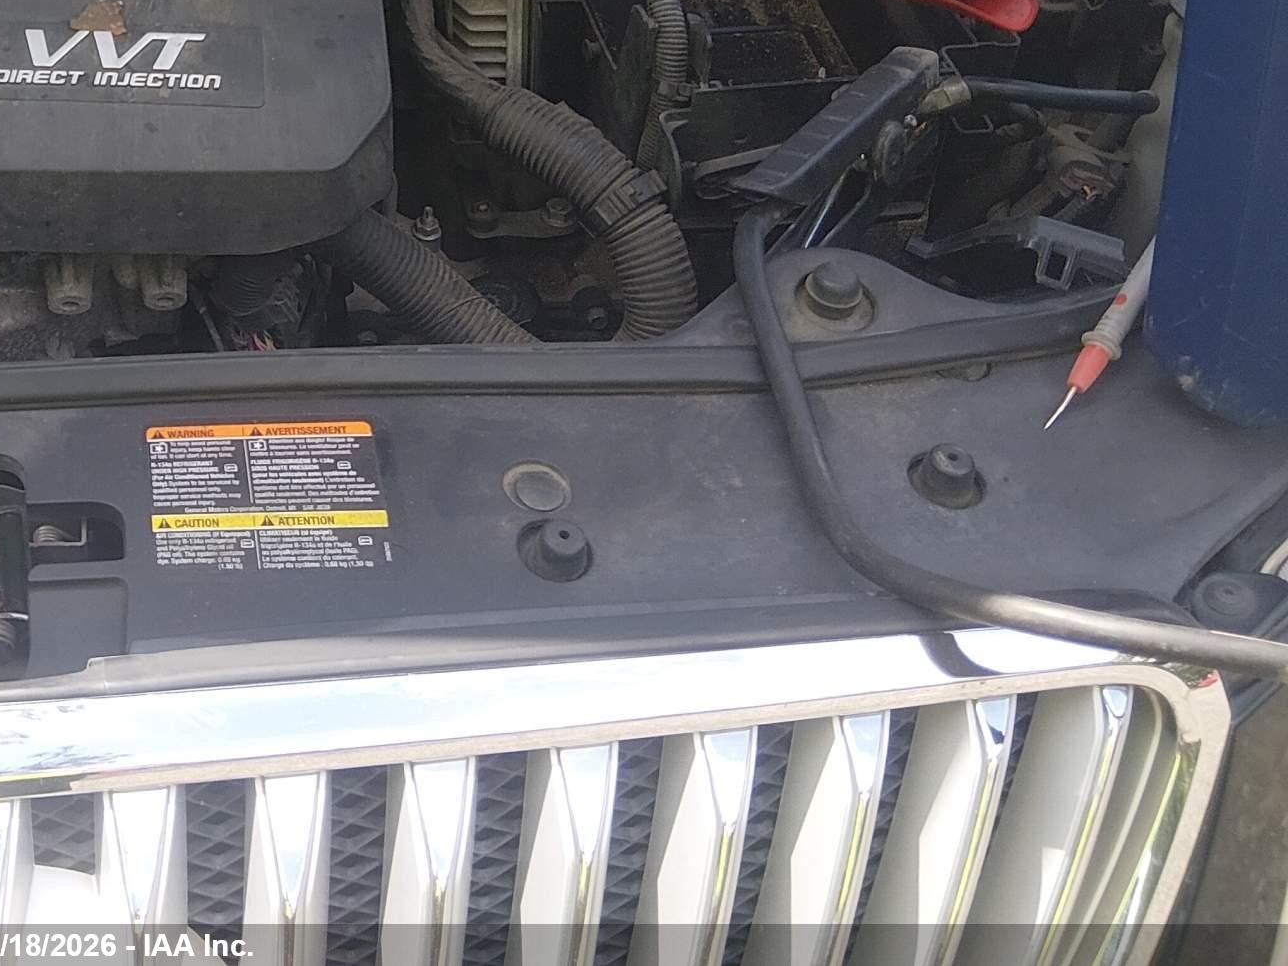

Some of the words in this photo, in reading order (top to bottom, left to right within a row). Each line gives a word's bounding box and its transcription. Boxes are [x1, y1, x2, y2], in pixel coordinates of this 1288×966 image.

[25, 29, 207, 71] VVT
[94, 72, 221, 89] INJECTION
[167, 430, 214, 439] WARNING
[266, 426, 347, 436] AVERTISSEMENT
[174, 518, 220, 528] CAUTION
[278, 516, 335, 526] ATTENTION
